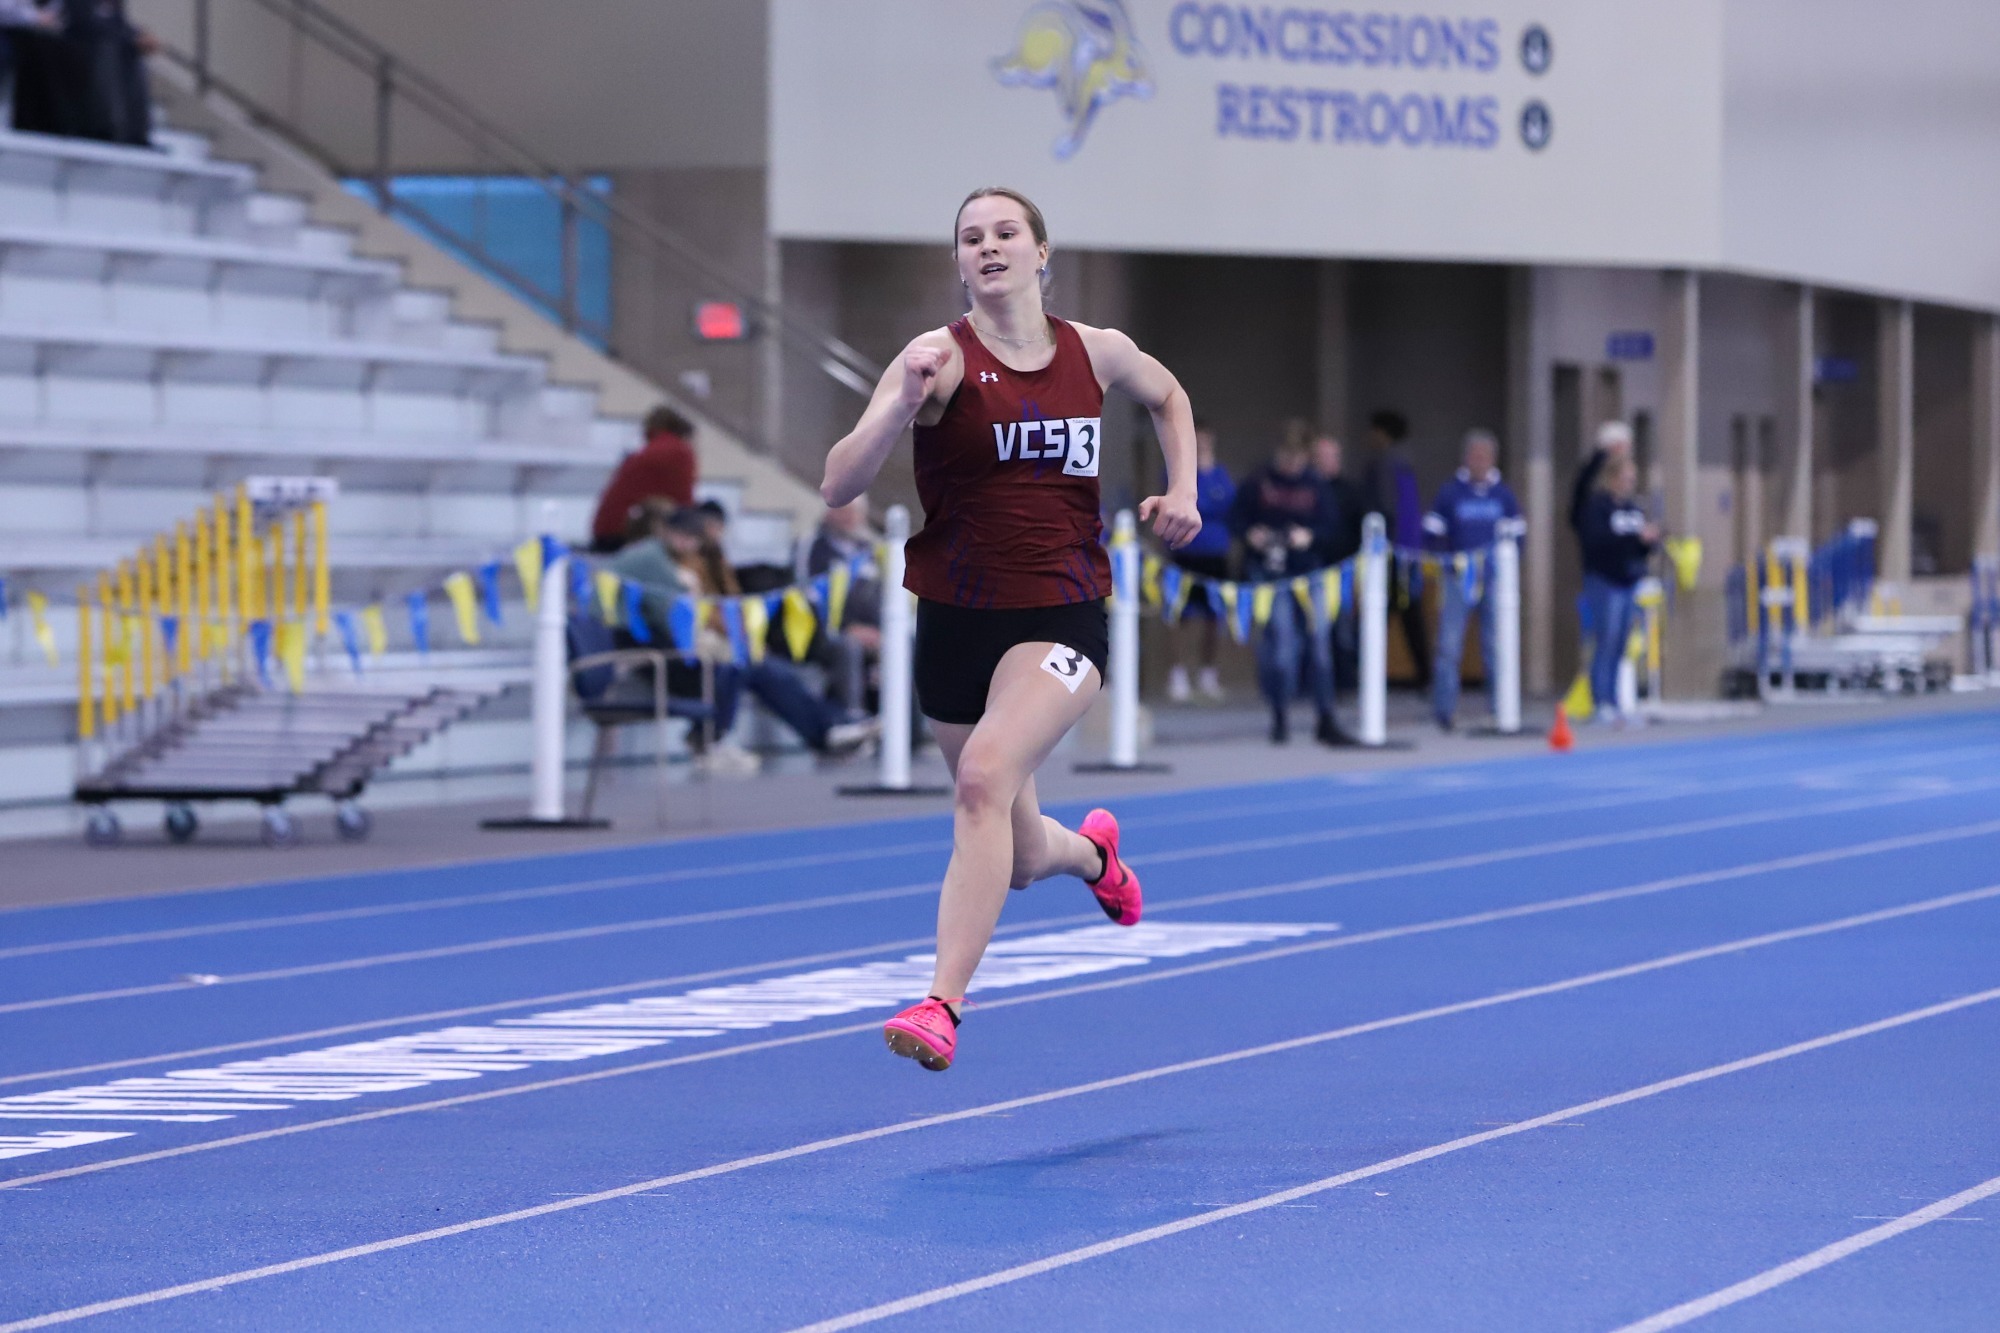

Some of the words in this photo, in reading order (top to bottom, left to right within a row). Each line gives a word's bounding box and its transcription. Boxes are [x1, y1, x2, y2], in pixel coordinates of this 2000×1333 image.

[1170, 0, 1500, 71] CONCESSIONS
[1216, 83, 1500, 148] RESTROOMS
[992, 418, 1071, 461] VCS
[1071, 424, 1095, 469] 3
[1050, 645, 1084, 676] 3
